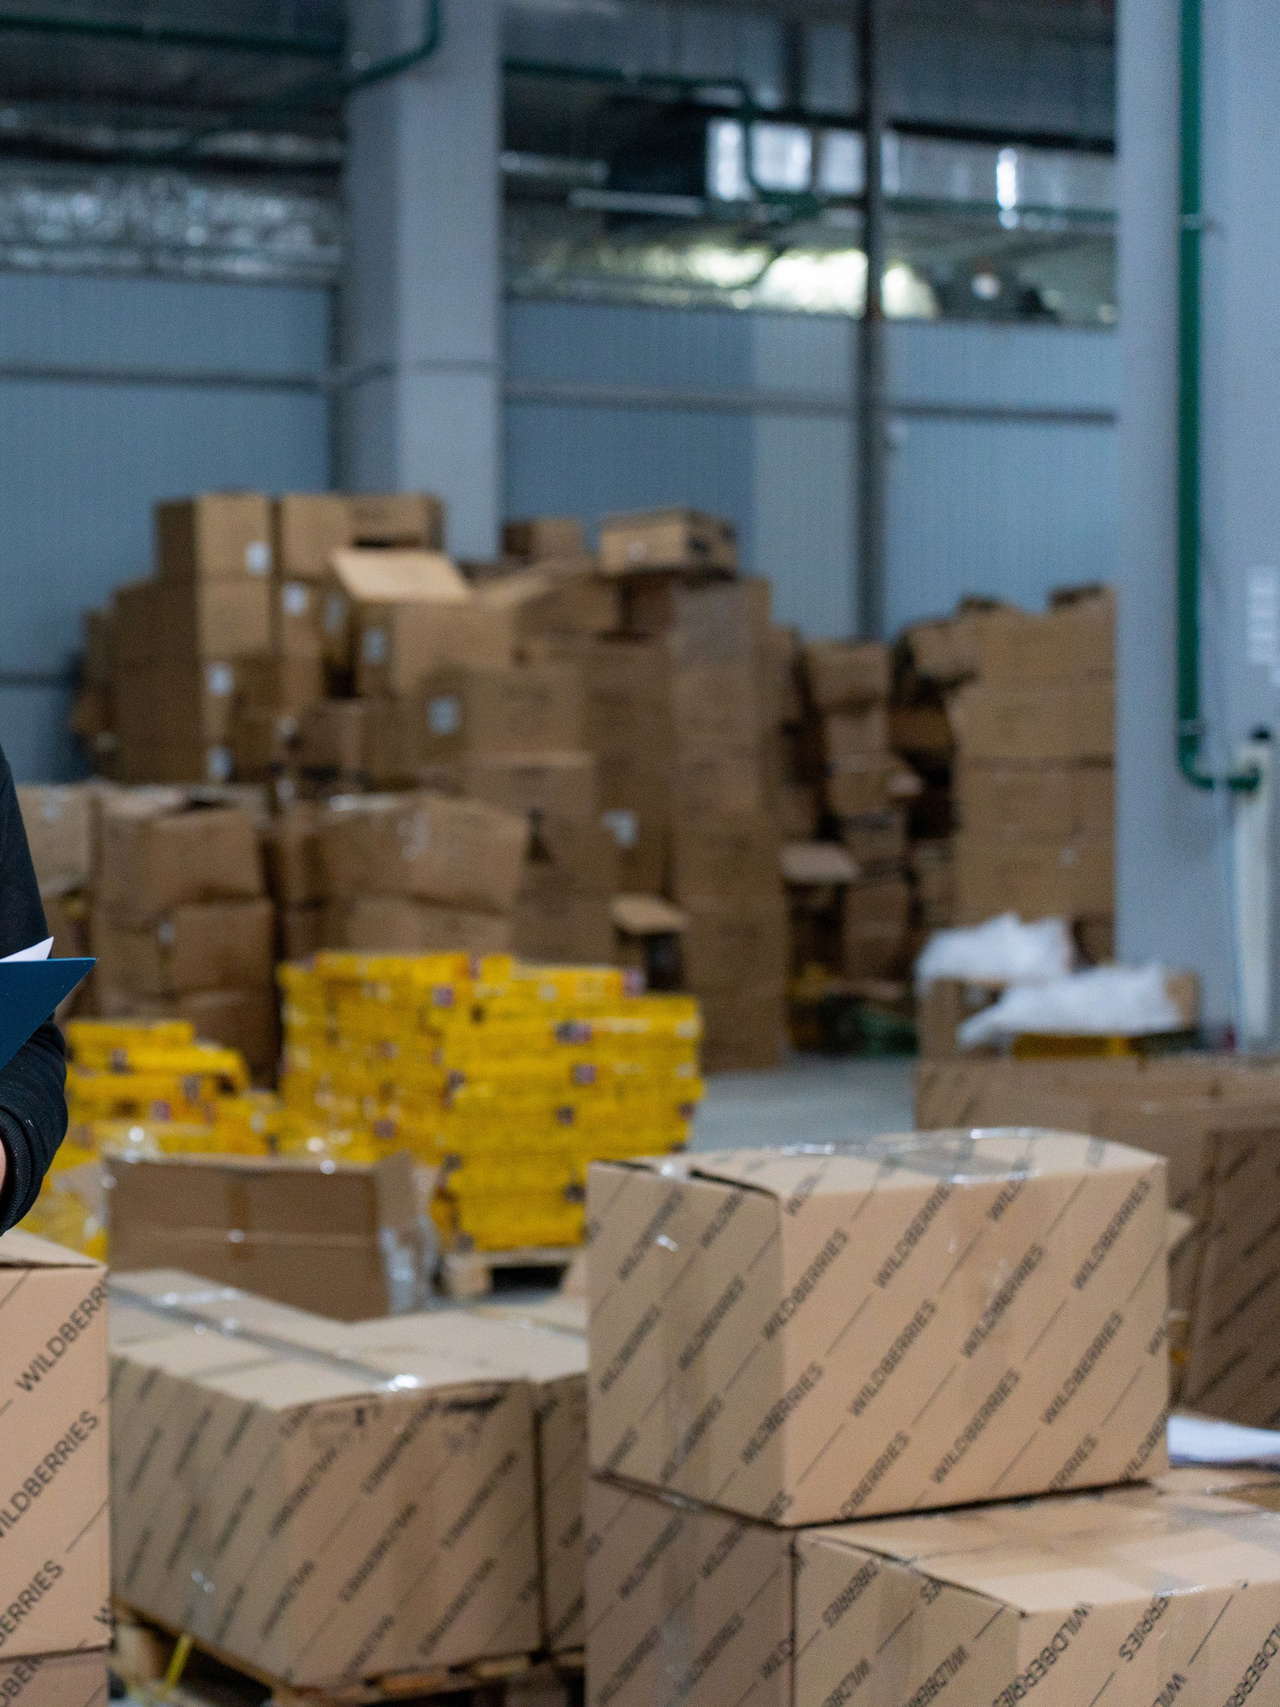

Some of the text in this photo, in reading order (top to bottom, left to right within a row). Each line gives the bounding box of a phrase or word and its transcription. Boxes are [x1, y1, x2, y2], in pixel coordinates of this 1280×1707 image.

[762, 1228, 849, 1341] WILDBERRIES
[847, 1299, 938, 1417] WILDBERRIES
[1040, 1310, 1123, 1425] WILDBERRIES
[931, 1366, 1020, 1484] WILDBERRIES
